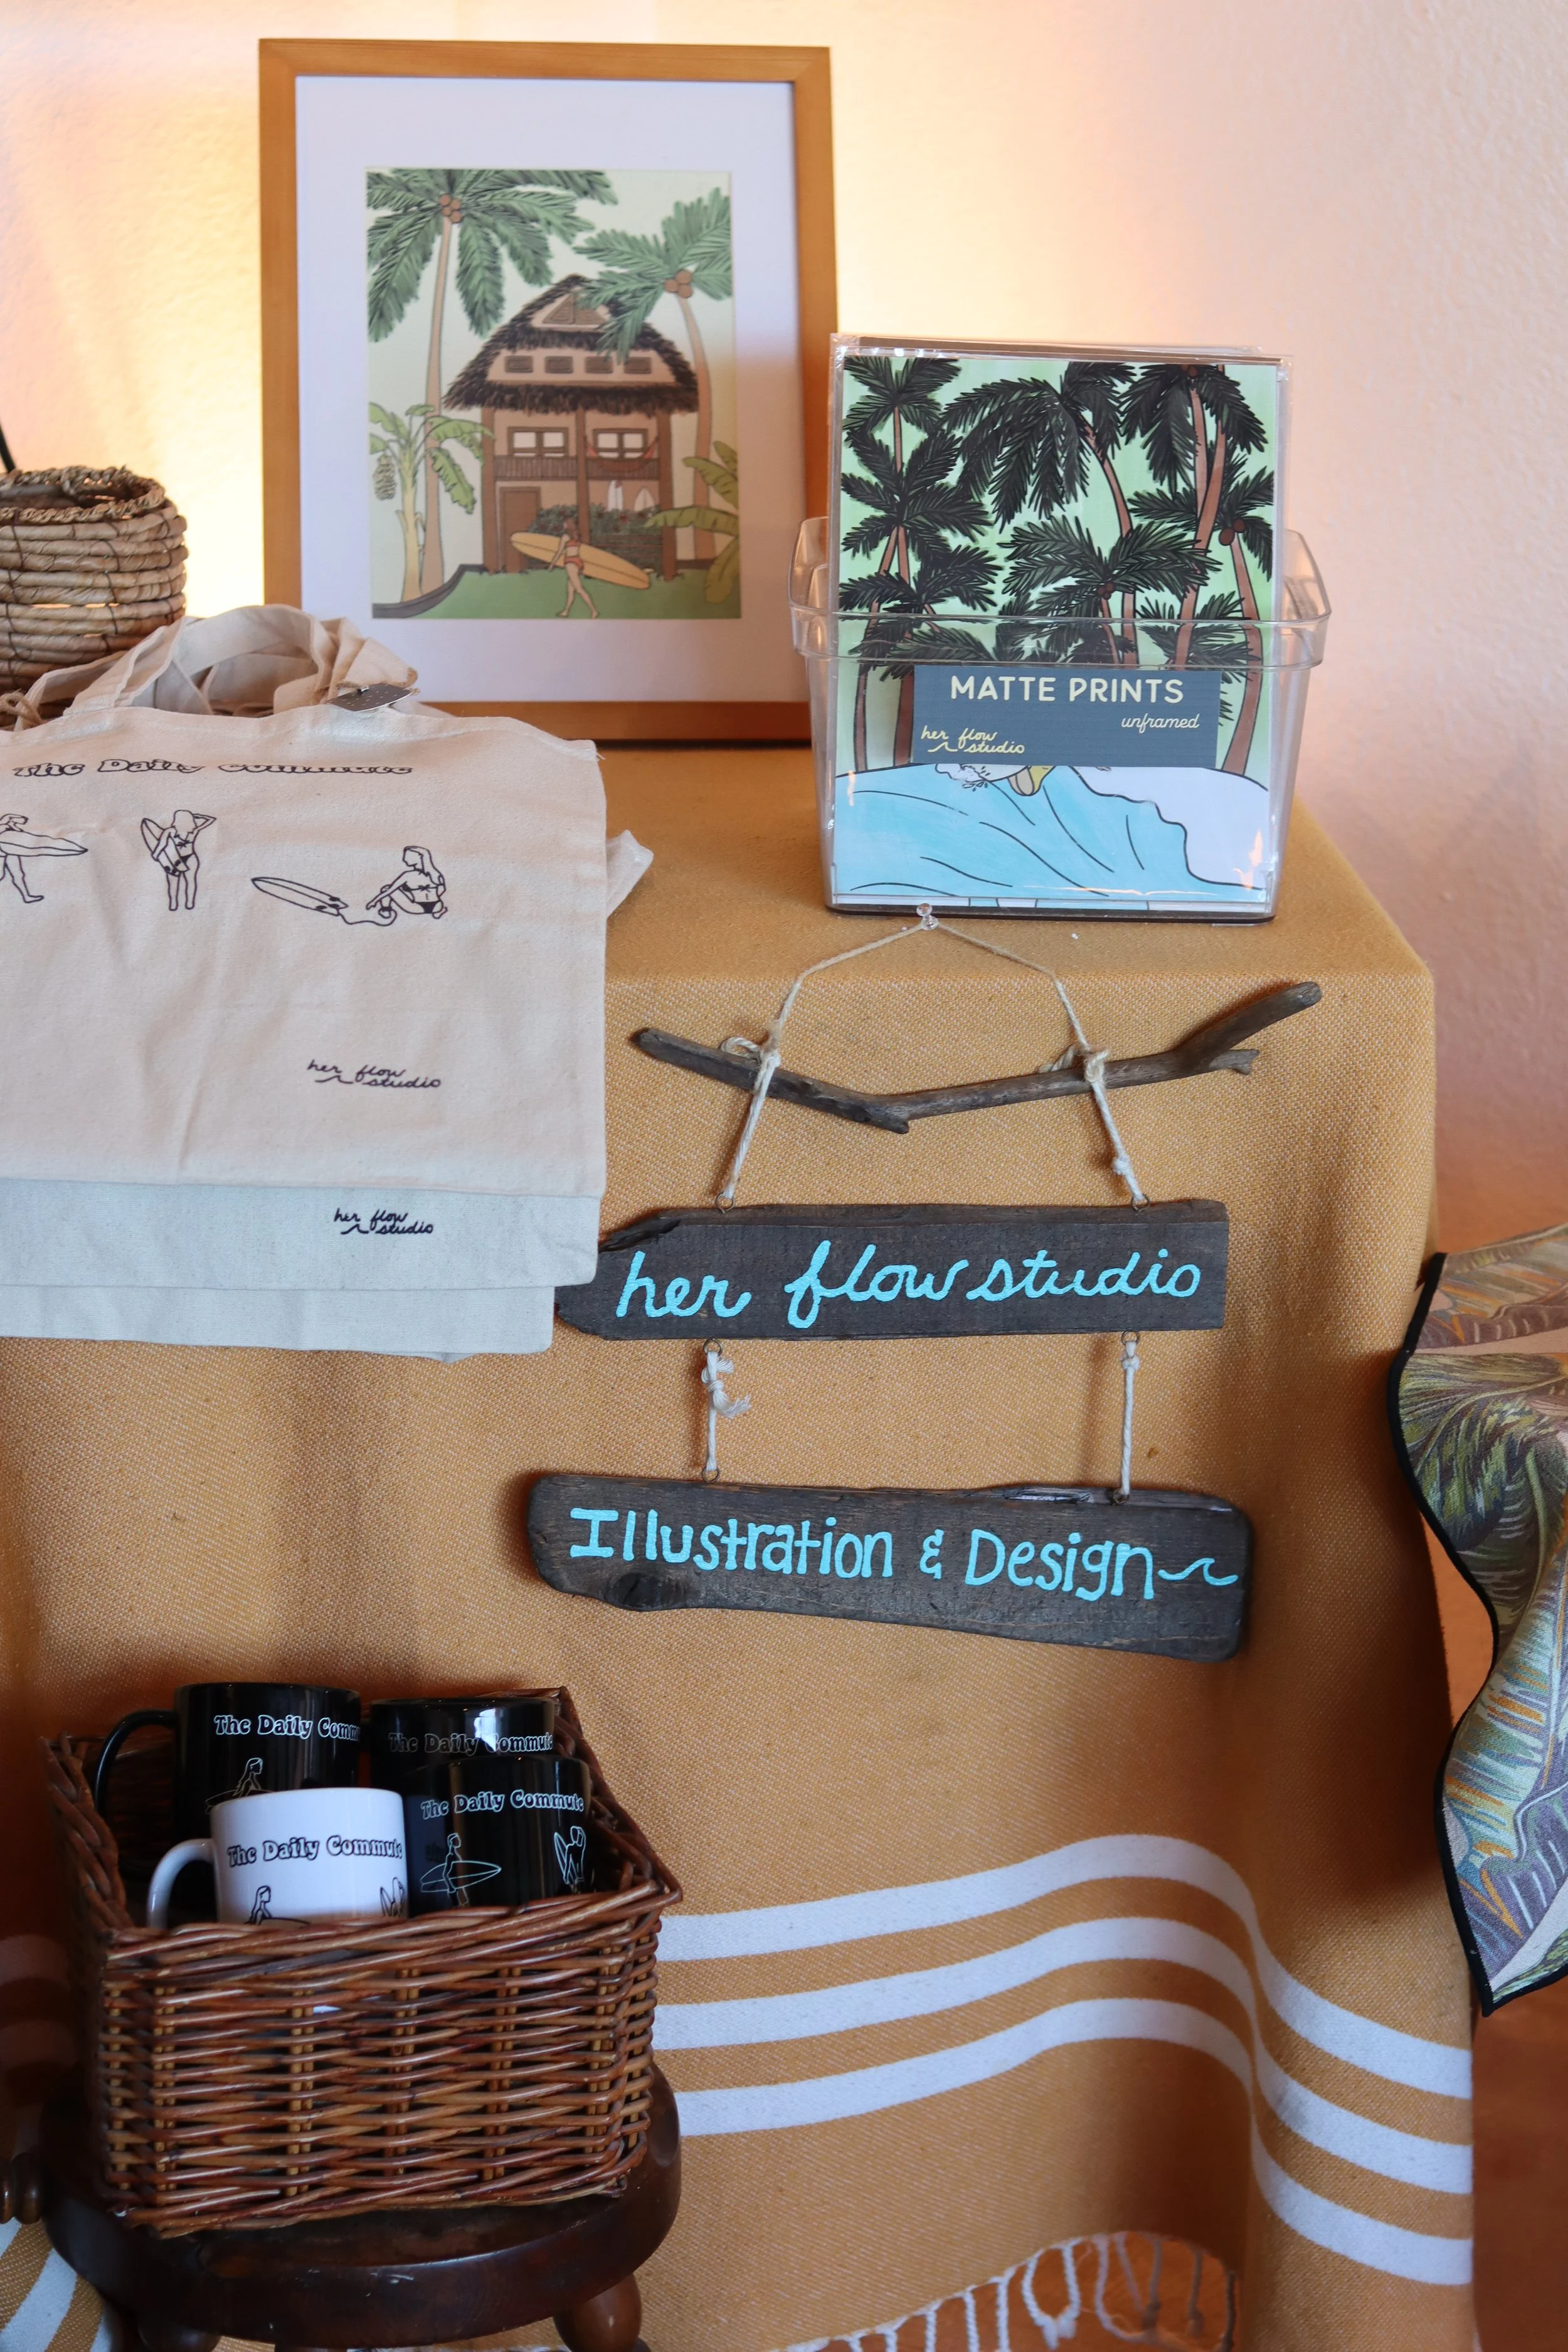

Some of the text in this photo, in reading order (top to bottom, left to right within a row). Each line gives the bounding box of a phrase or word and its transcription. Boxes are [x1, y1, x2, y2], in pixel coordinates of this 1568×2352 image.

[950, 675, 1184, 704] MATTE PRINTS
[1121, 713, 1200, 733] unframed
[921, 725, 998, 749] her flow
[963, 741, 1025, 754] studio
[12, 763, 86, 776] The
[307, 1059, 406, 1083] her flow
[362, 1077, 442, 1088] studio
[334, 1207, 408, 1231] her flow
[375, 1221, 433, 1234] studio
[616, 1241, 1201, 1328] her flow studio
[569, 1507, 1155, 1601] Illustration & Design
[214, 1715, 251, 1735] The
[257, 1714, 313, 1740] Daily
[388, 1732, 419, 1752] The
[424, 1733, 479, 1756] Daily
[421, 1789, 585, 1820] The Daily Commute
[227, 1844, 257, 1868] The
[262, 1836, 320, 1862] Daily
[326, 1835, 403, 1860] Commute
